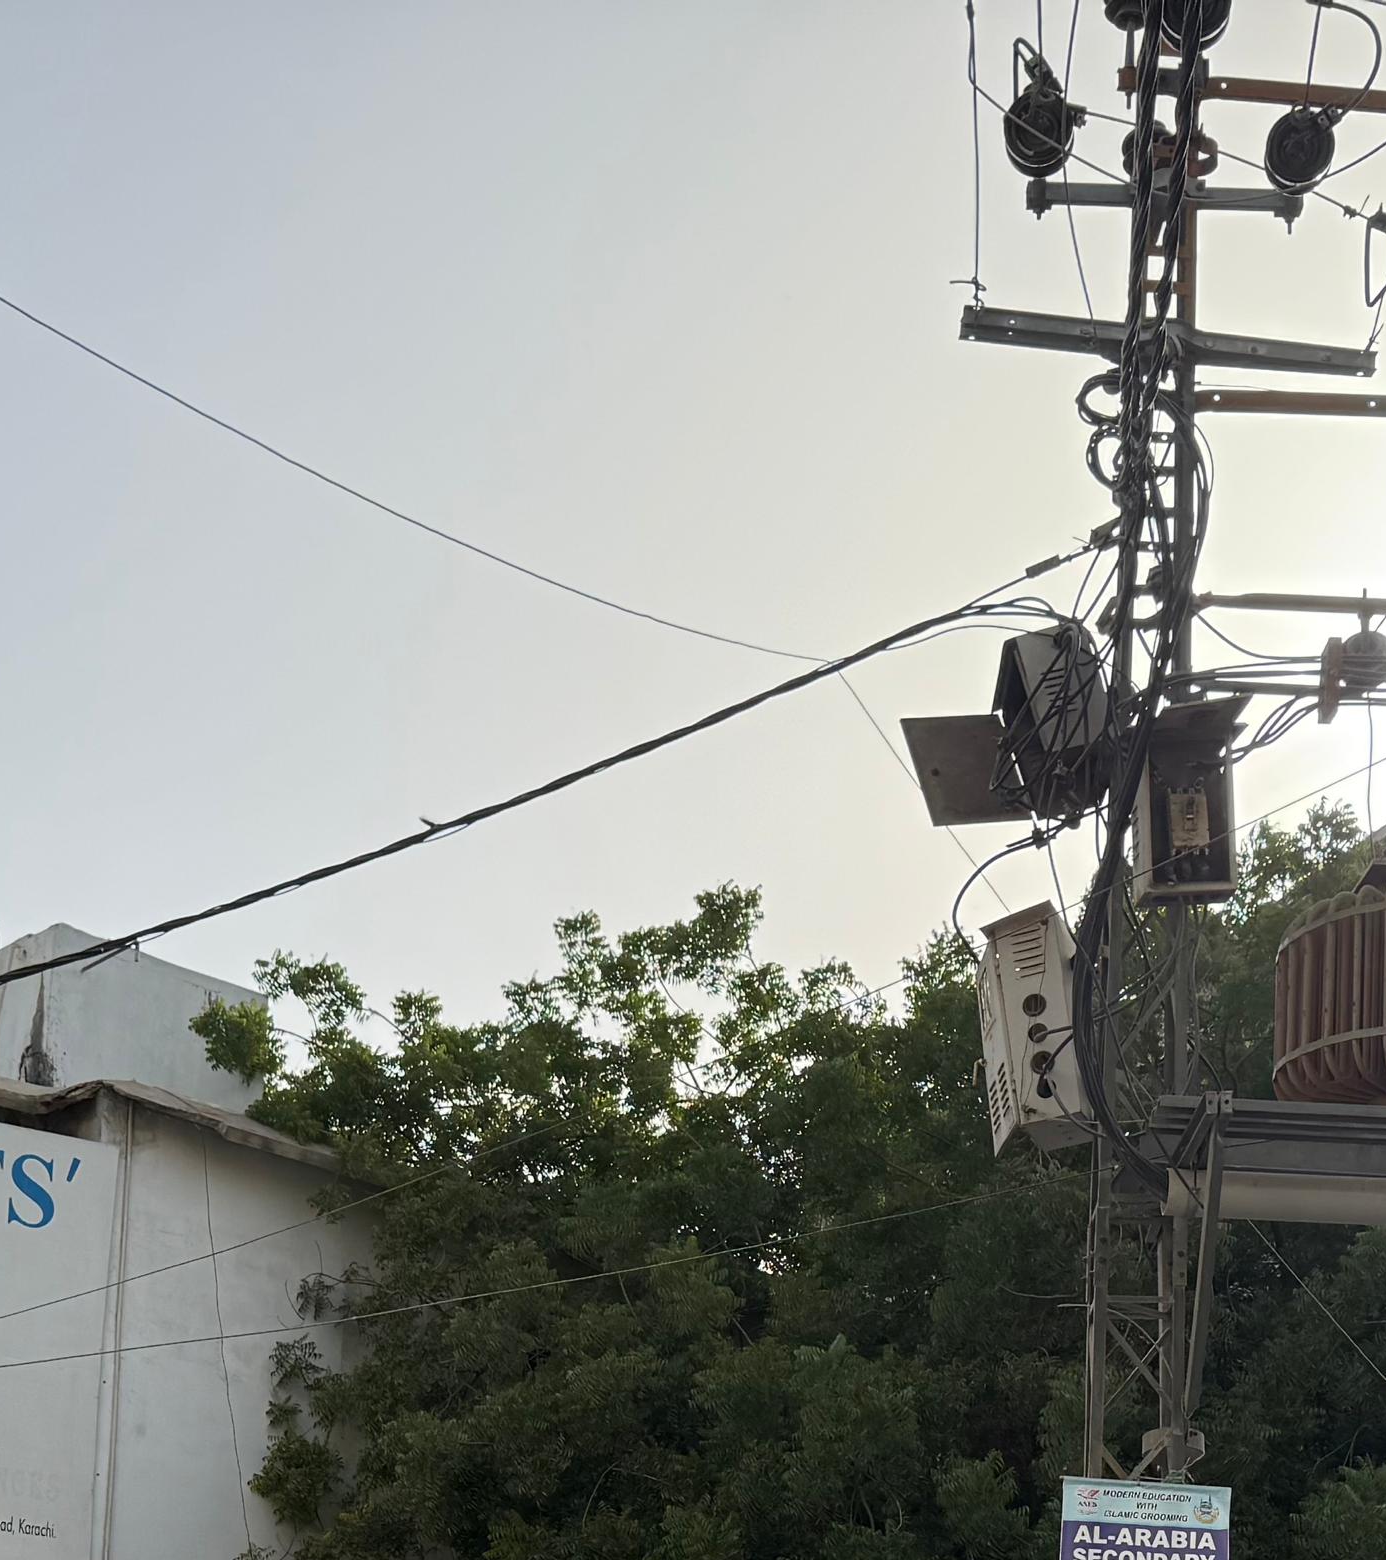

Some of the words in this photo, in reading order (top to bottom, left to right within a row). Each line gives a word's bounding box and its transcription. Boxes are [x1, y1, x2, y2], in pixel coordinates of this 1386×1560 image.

[1102, 1489, 1141, 1500] MODERN
[1142, 1492, 1192, 1503] EDUCATION
[1136, 1501, 1158, 1511] WITH
[1104, 1509, 1139, 1519] ISLAMIC
[1140, 1512, 1189, 1522] GROOMING
[1073, 1525, 1216, 1550] AL-ARABIA
